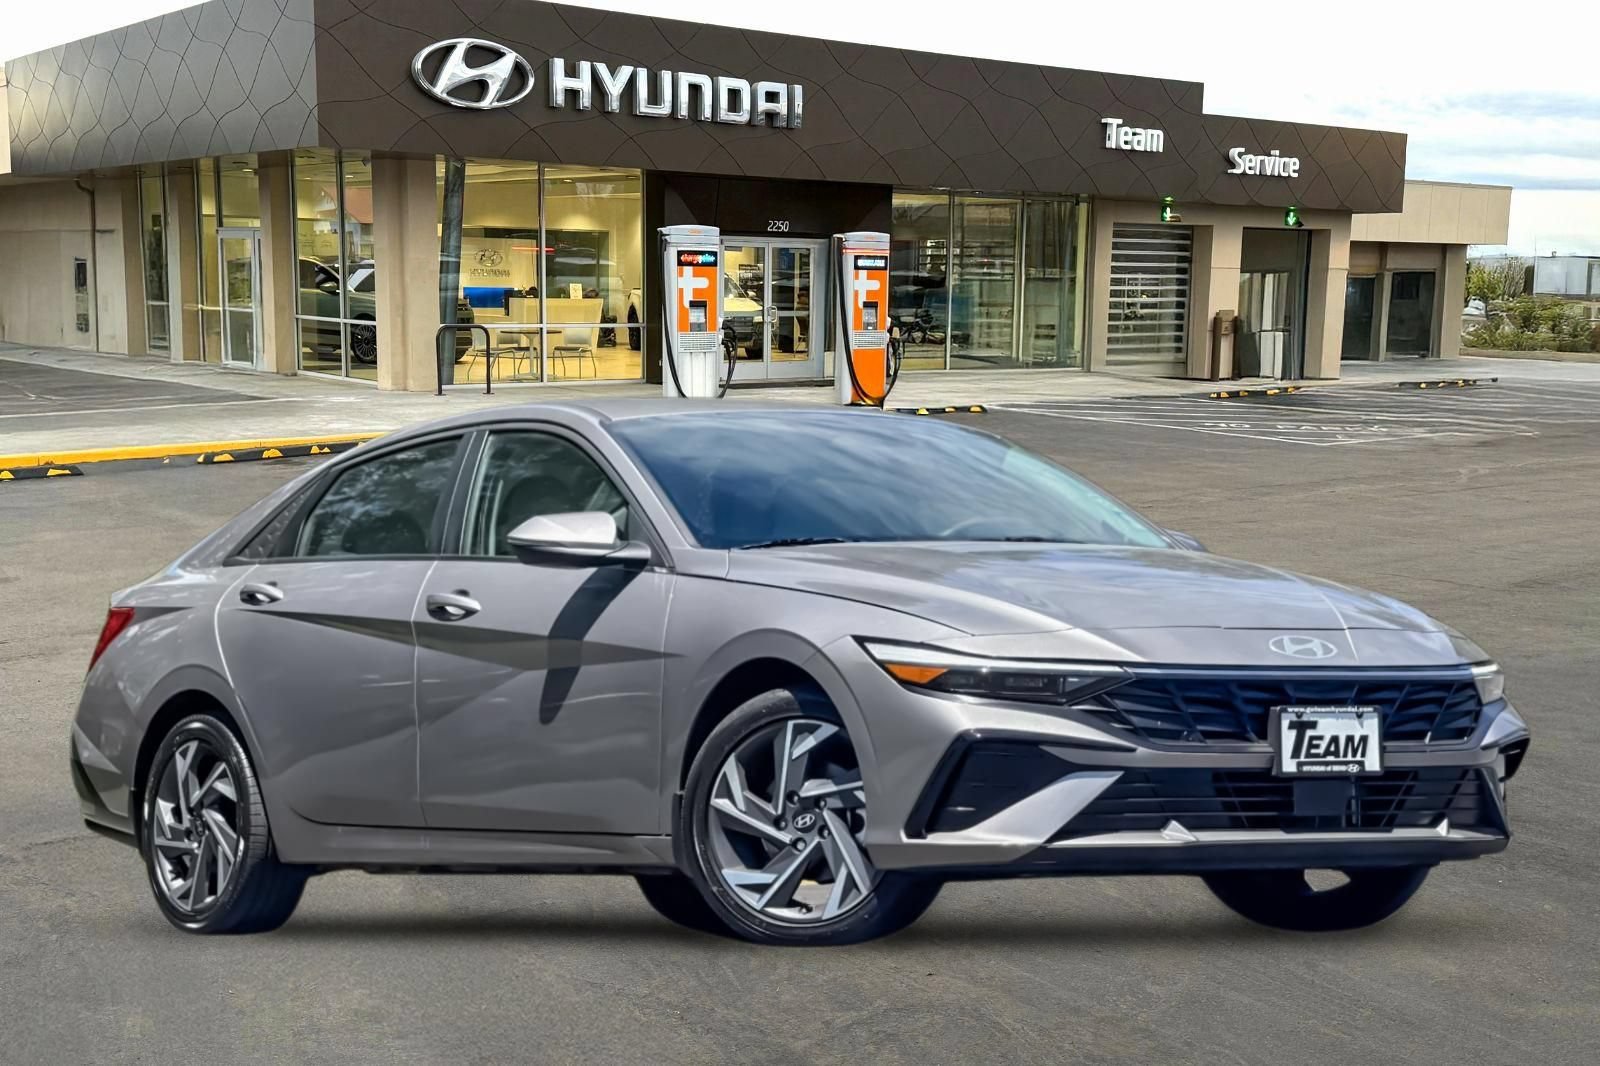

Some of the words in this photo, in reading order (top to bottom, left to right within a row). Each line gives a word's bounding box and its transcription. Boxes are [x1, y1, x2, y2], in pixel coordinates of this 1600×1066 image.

[548, 57, 803, 129] HYUNDAI
[1101, 117, 1164, 152] Team
[1227, 147, 1300, 178] Service
[767, 220, 790, 232] 2250
[1287, 720, 1369, 759] TEAM
